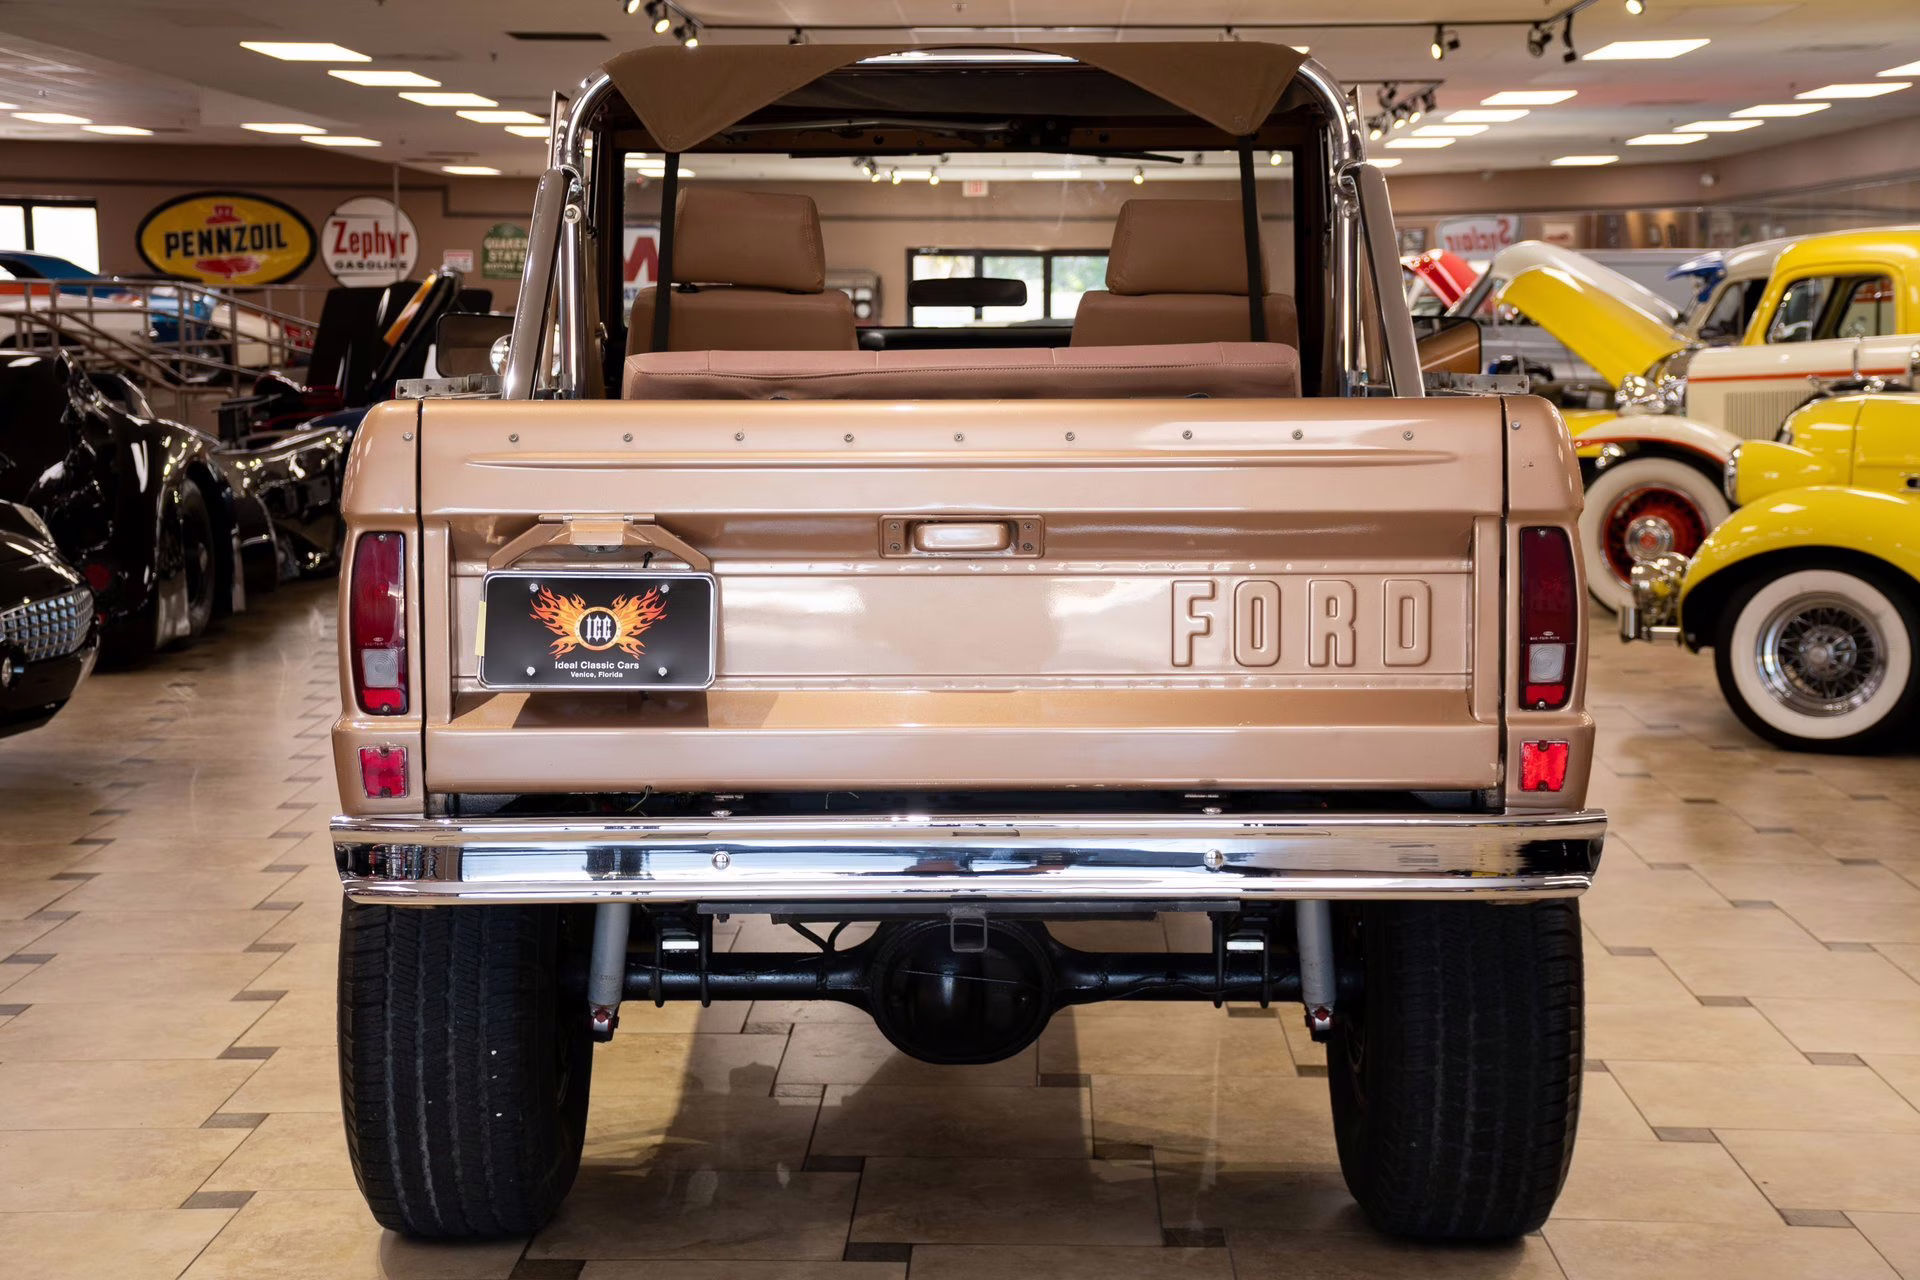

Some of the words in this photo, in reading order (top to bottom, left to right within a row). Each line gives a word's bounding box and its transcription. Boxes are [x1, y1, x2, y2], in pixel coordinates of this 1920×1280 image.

[164, 223, 287, 260] PENNZOIL
[332, 220, 409, 259] Zephyr
[334, 261, 407, 269] GASOLINE
[586, 614, 611, 643] ICC
[1171, 579, 1432, 667] FORD
[555, 661, 578, 669] Ideal
[580, 661, 615, 669] Classic
[617, 661, 639, 669] Cars
